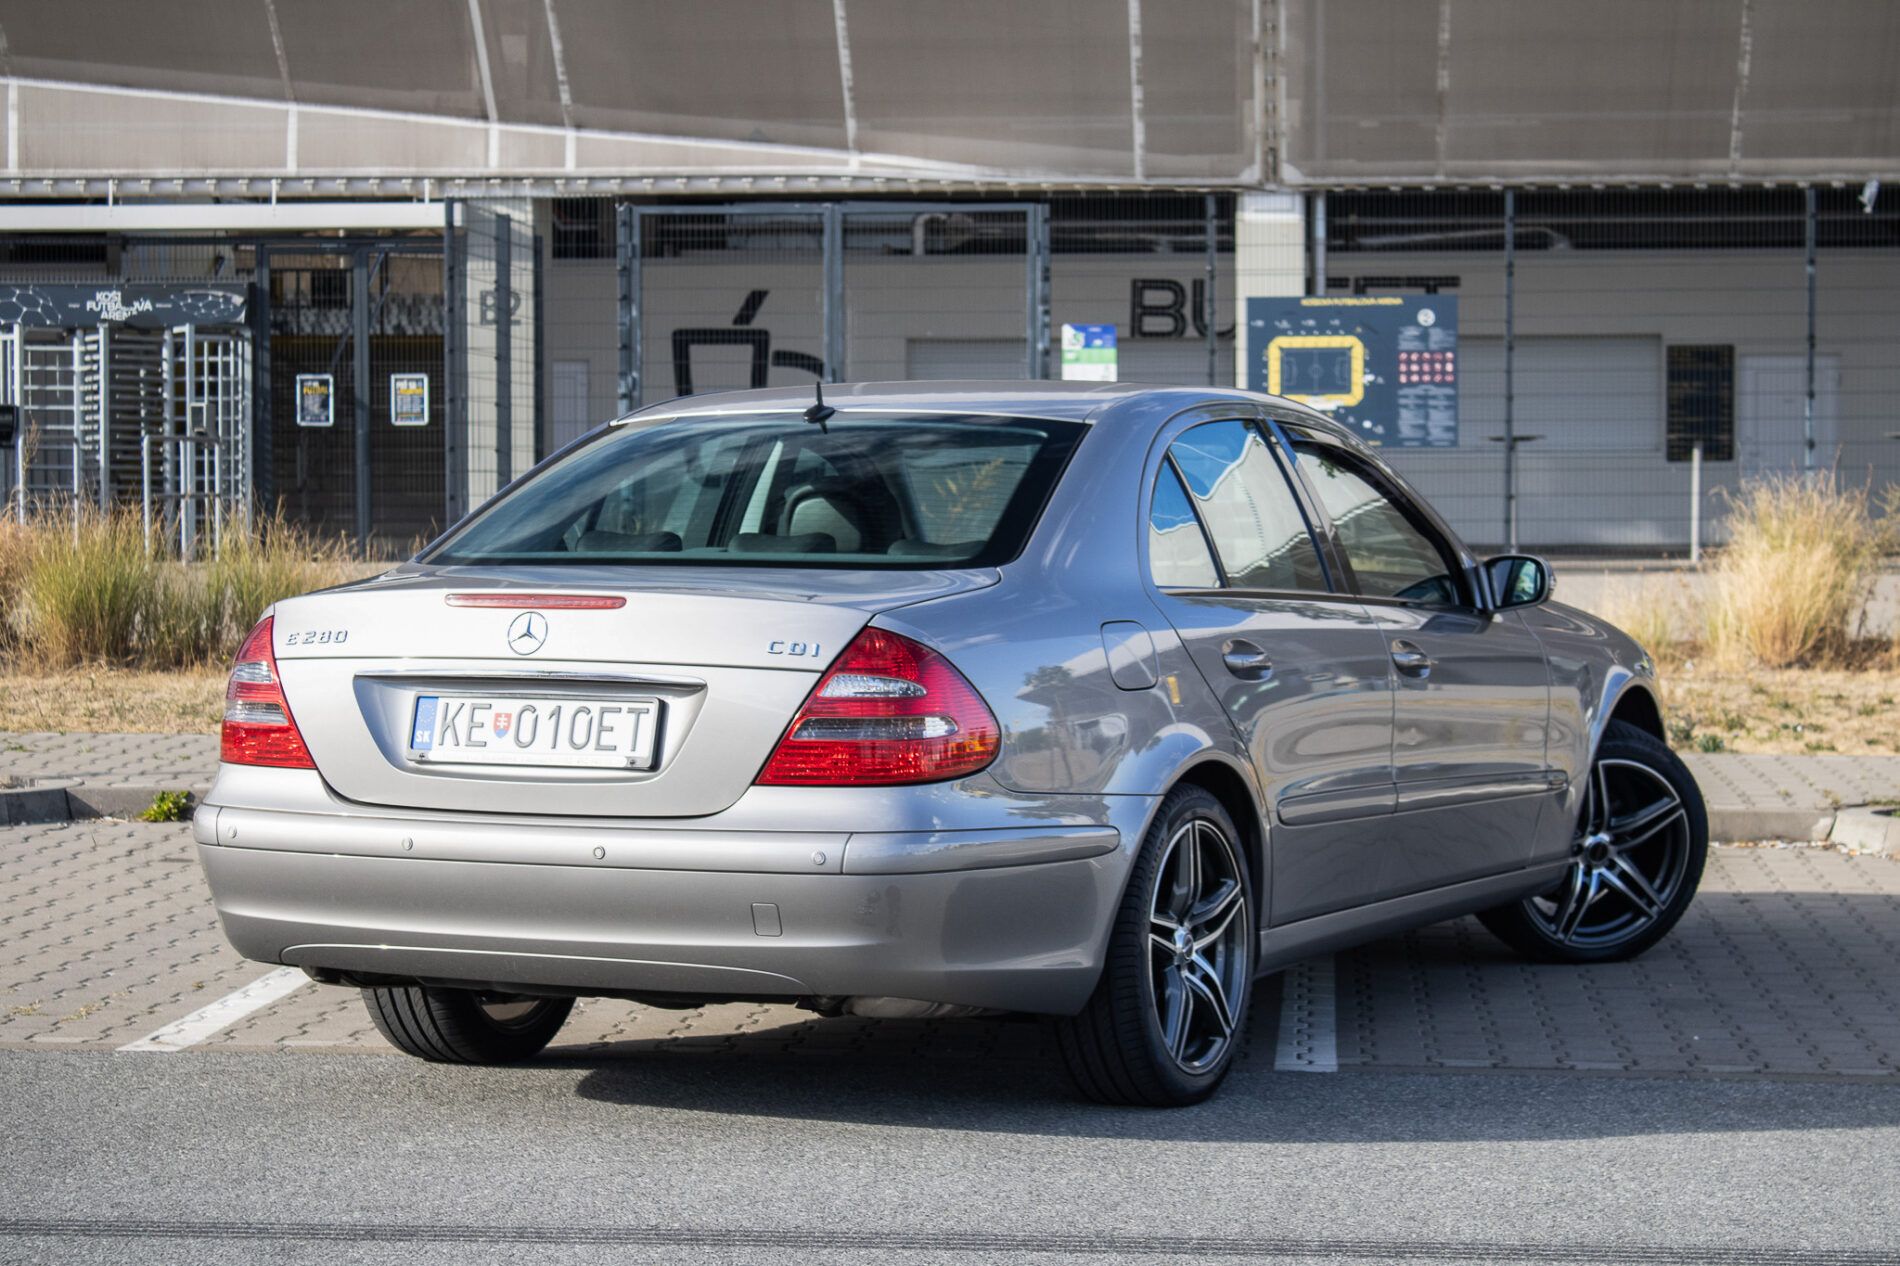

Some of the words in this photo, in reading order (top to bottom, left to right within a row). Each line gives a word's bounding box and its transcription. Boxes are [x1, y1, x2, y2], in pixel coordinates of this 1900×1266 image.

[285, 632, 300, 646] E
[302, 630, 349, 645] 280
[767, 640, 820, 657] CDI
[438, 702, 492, 748] KE
[513, 703, 650, 752] 010ET
[416, 730, 431, 743] SK
